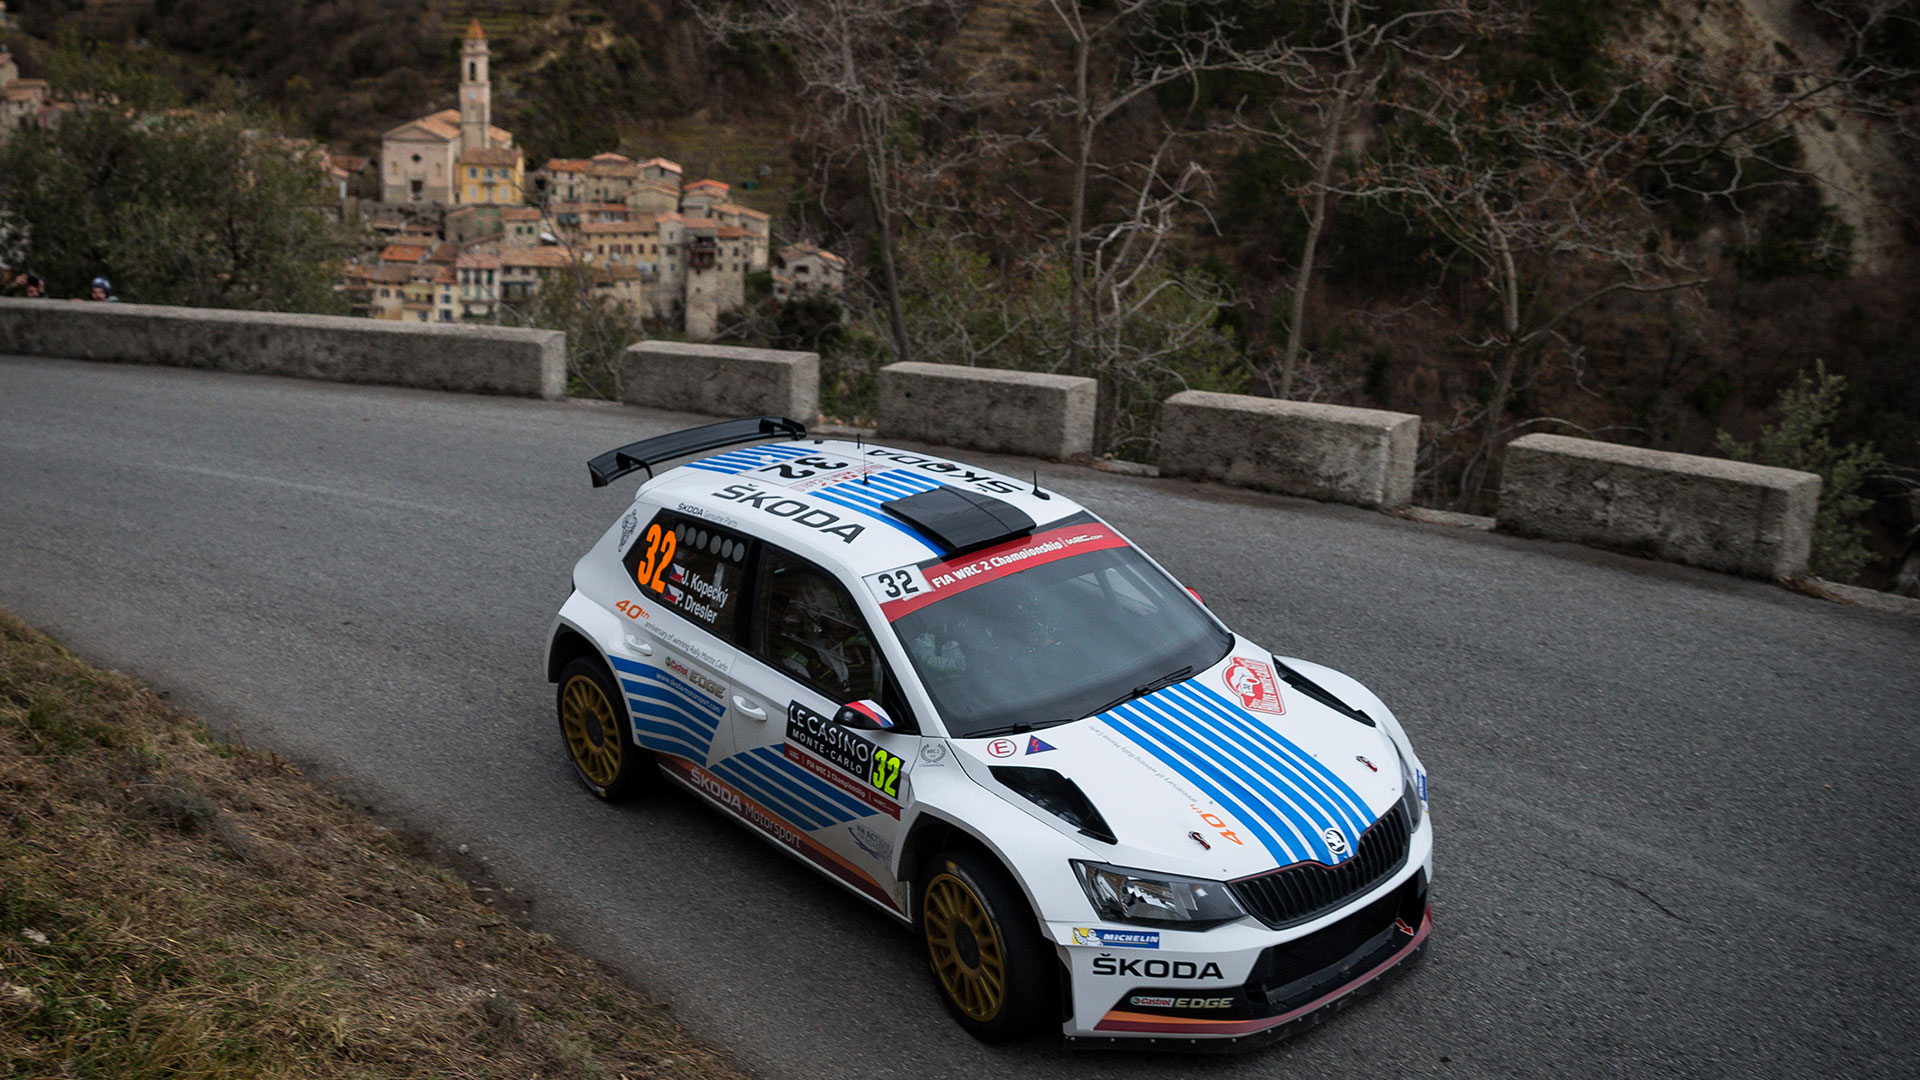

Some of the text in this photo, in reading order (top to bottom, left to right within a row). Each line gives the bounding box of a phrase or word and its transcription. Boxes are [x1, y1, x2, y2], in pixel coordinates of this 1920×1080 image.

[759, 457, 848, 480] 32
[677, 503, 703, 516] ŠKODA
[723, 517, 738, 527] Parts
[711, 483, 866, 544] ŠKODA
[638, 523, 677, 594] 32
[931, 573, 954, 590] FIA
[952, 566, 981, 582] WRC
[981, 561, 990, 572] 2
[989, 540, 1063, 568] Championship
[681, 570, 729, 608] J. Kopecký
[879, 569, 919, 598] 32
[615, 600, 651, 620] 40th
[675, 591, 718, 624] P. Dresler
[690, 645, 701, 658] Rally
[700, 651, 716, 666] Monte
[715, 659, 728, 672] Carlo
[689, 669, 726, 700] EDGE
[993, 741, 1010, 754] E
[806, 759, 815, 769] FIA
[831, 771, 866, 798] Championship
[873, 749, 901, 797] 32
[690, 766, 742, 812] ŠKODA
[744, 801, 801, 849] Motorsport
[1189, 804, 1244, 846] 40th
[1103, 932, 1160, 943] MICHELIN
[1092, 953, 1224, 980] ŠKODA
[1174, 997, 1235, 1009] EDGE
